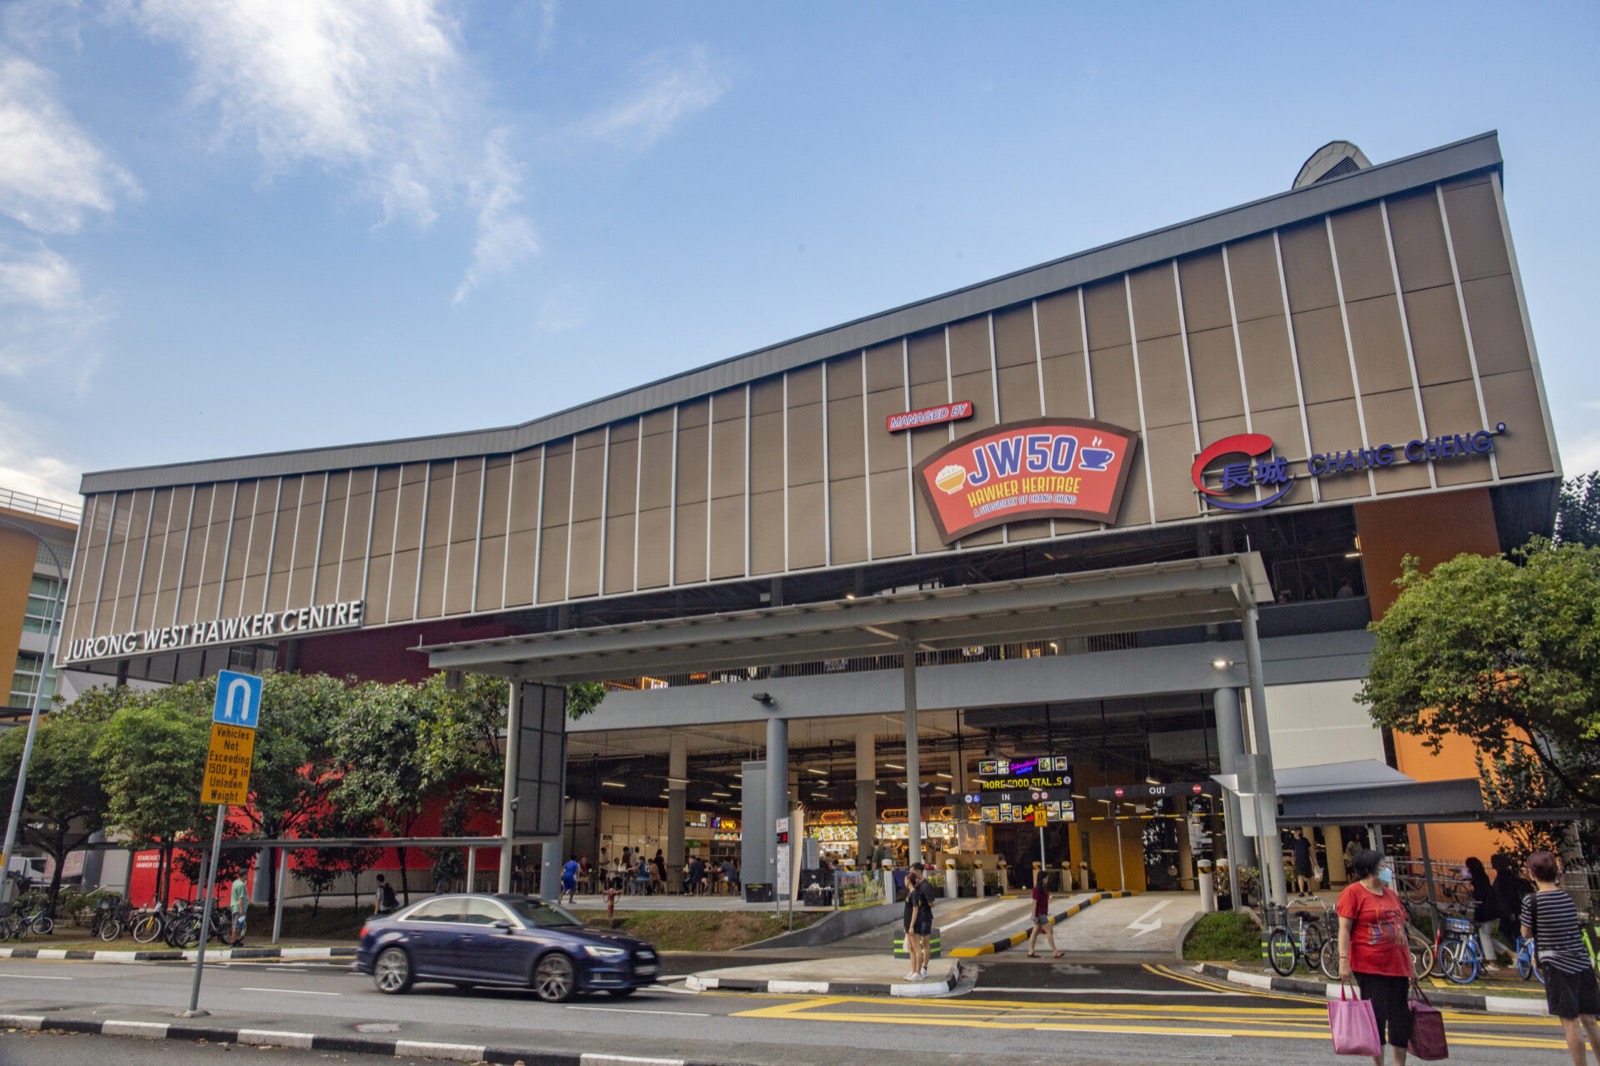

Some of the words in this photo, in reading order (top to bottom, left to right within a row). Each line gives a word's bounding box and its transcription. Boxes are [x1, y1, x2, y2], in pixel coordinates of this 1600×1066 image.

[890, 407, 949, 428] MANAGED
[951, 403, 968, 417] BY
[967, 434, 1078, 486] JW50
[1308, 444, 1395, 476] CHANG
[1405, 430, 1493, 462] CHENG
[1219, 456, 1288, 490] 長城
[967, 480, 1019, 508] HAWKER
[1022, 476, 1082, 493] HERITAGE
[979, 496, 1018, 515] SUBSIDIARY
[1019, 495, 1028, 504] OF
[1029, 493, 1052, 504] CHANG
[1053, 494, 1077, 505] CHENG
[64, 632, 137, 660] JURONG
[144, 624, 190, 650] WEST
[191, 613, 275, 645] HAWKER
[281, 600, 362, 632] CENTRE
[217, 726, 250, 740] Vehicles
[224, 740, 239, 751] Not
[209, 751, 250, 767] Exceeding
[208, 763, 226, 775] 1500
[229, 766, 238, 779] kg
[241, 768, 249, 777] In
[210, 777, 243, 789] Unladen
[982, 780, 1005, 789] MORE
[1031, 777, 1063, 787] STALS
[1149, 786, 1165, 795] OUT
[211, 789, 239, 803] Weight
